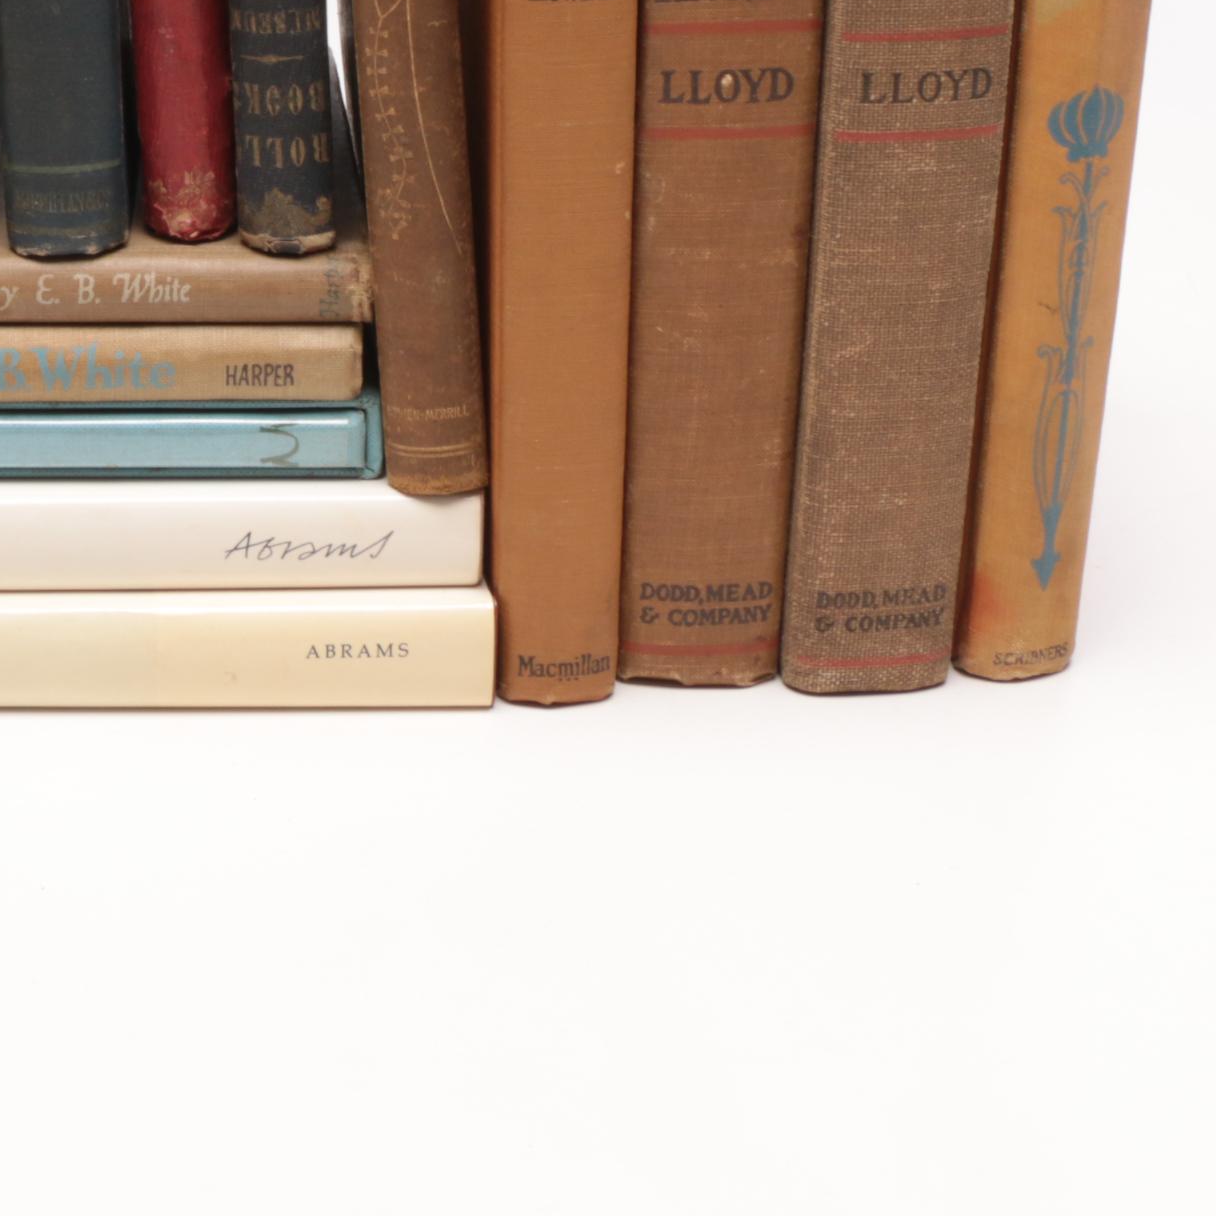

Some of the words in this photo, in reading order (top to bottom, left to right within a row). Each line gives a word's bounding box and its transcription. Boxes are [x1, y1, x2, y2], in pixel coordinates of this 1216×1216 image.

[658, 66, 795, 105] LLOYD
[860, 67, 993, 105] LLOYD
[36, 273, 61, 305] E.
[72, 272, 102, 305] B.
[112, 271, 193, 304] White
[225, 363, 295, 386] HARPER
[224, 530, 395, 561] Abrams
[640, 607, 660, 625] &
[668, 604, 773, 628] COMPANY
[815, 616, 835, 633] &
[845, 608, 946, 634] COMPANY
[305, 642, 411, 660] ABRAMS
[517, 652, 611, 680] Macmillan
